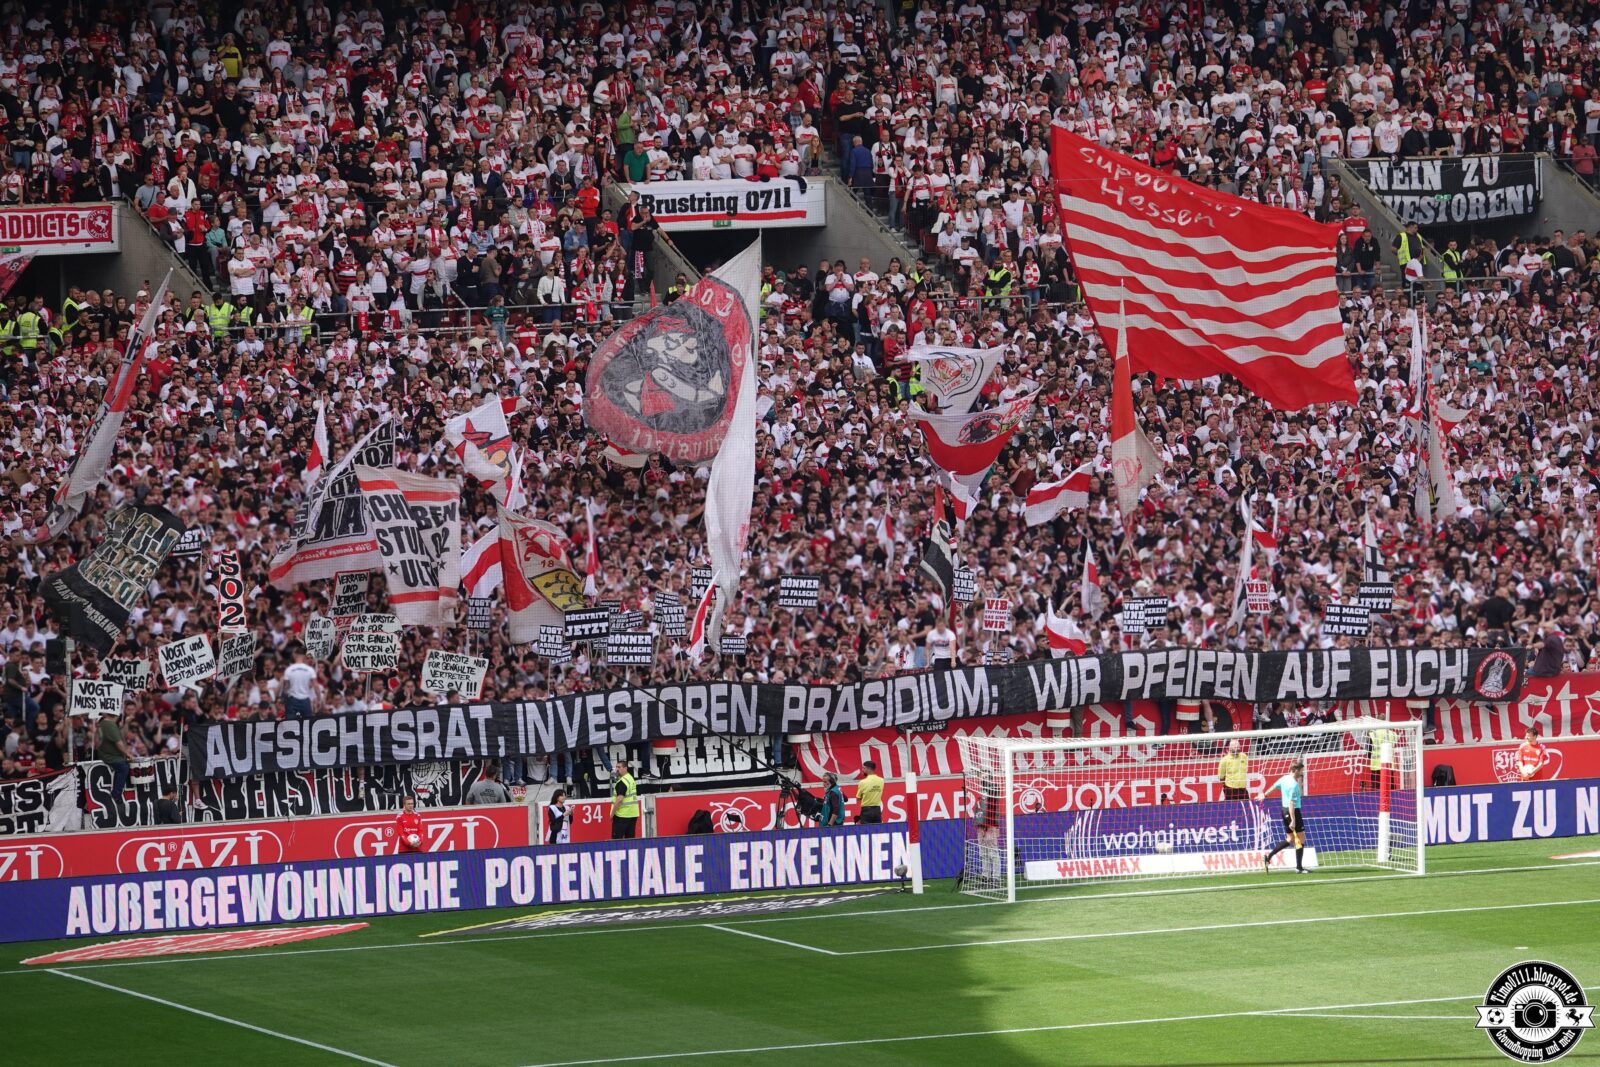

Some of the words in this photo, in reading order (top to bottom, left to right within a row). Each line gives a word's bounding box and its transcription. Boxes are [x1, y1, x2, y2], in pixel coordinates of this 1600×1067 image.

[1368, 160, 1443, 191] NEIN
[1462, 156, 1500, 188] ZU
[641, 191, 738, 216] Brustring
[746, 187, 791, 211] 0711
[1101, 177, 1216, 229] Hessen
[954, 571, 974, 580] VOGT
[343, 584, 358, 594] UND
[781, 577, 819, 589] GÖNNER
[953, 579, 974, 588] UND
[1360, 586, 1393, 594] RÜCKTRITT
[779, 598, 817, 606] SCHLANGE
[986, 600, 1008, 610] VfB
[1360, 598, 1392, 608] JETZT
[468, 607, 490, 616] UND
[565, 611, 609, 622] RÜCKTRITT
[1124, 610, 1145, 620] UND
[664, 614, 685, 622] UND
[540, 626, 563, 634] VOGT
[565, 622, 609, 636] JETZT
[984, 620, 1006, 629] WIR
[1324, 624, 1368, 636] KAPUTT
[348, 633, 364, 642] FÜR
[368, 634, 393, 643] EINEN
[540, 634, 563, 643] UND
[608, 634, 651, 645] GÖNNER
[161, 643, 187, 661] VOGT
[190, 638, 205, 652] und
[345, 644, 383, 654] STARKEN
[539, 648, 562, 656] RAUS
[165, 655, 197, 675] ADRION
[343, 656, 368, 668] VOGT
[371, 656, 398, 668] RAUS!
[428, 651, 469, 665] AR-VORSITZ
[474, 659, 486, 669] NUR
[607, 655, 651, 663] SCHLANGE
[105, 659, 140, 675] VOGT
[428, 661, 441, 669] FÜR
[442, 662, 477, 675] GEWÄHLTE
[126, 672, 150, 690] WEG!
[430, 670, 471, 681] VERTRETER
[79, 683, 113, 697] VOGT
[426, 679, 444, 689] DES
[782, 667, 998, 733] PRÄSIDIUM:
[1028, 657, 1101, 711] WIR
[1121, 652, 1259, 700] PFEIFEN
[1277, 651, 1350, 698] AUF
[1370, 649, 1469, 697] EUCH!
[74, 697, 96, 710] MUSS
[99, 698, 119, 711] WEG!
[1344, 757, 1363, 776] 35
[582, 805, 603, 824] 34
[1424, 793, 1493, 845] MUT
[1512, 789, 1556, 838] ZU
[1102, 823, 1240, 851] wohninvest
[486, 846, 705, 906] POTENTIALE
[730, 831, 911, 890] ERKENNEN
[1057, 856, 1142, 877] WINAMAX
